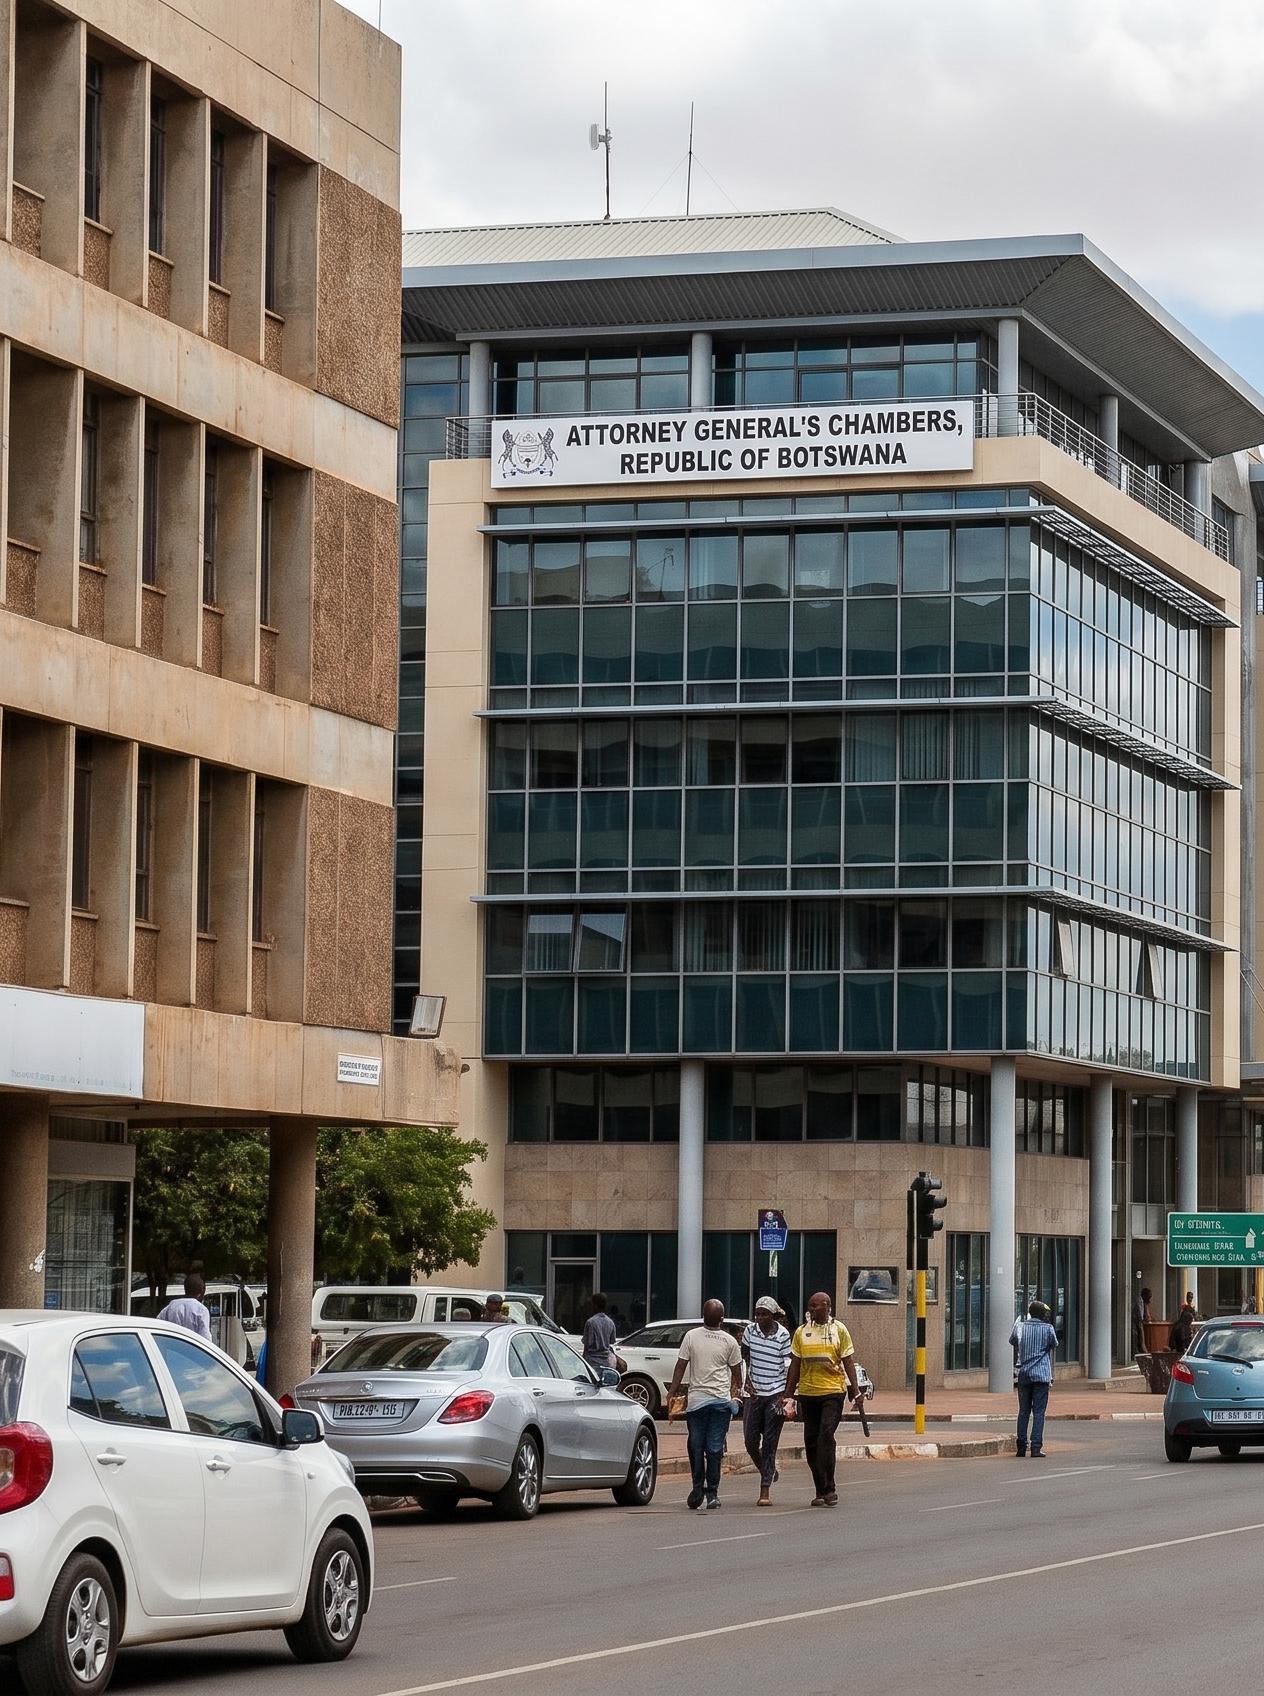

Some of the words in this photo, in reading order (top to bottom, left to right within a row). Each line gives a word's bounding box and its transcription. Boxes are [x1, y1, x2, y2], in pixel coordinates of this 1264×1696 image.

[565, 421, 688, 447] ATTORNEY
[694, 415, 821, 442] GENERAL'S
[828, 409, 963, 436] CHAMBERS,
[620, 449, 733, 475] REPUBLIC
[740, 447, 770, 471] OF
[777, 442, 907, 469] BOTSWANA
